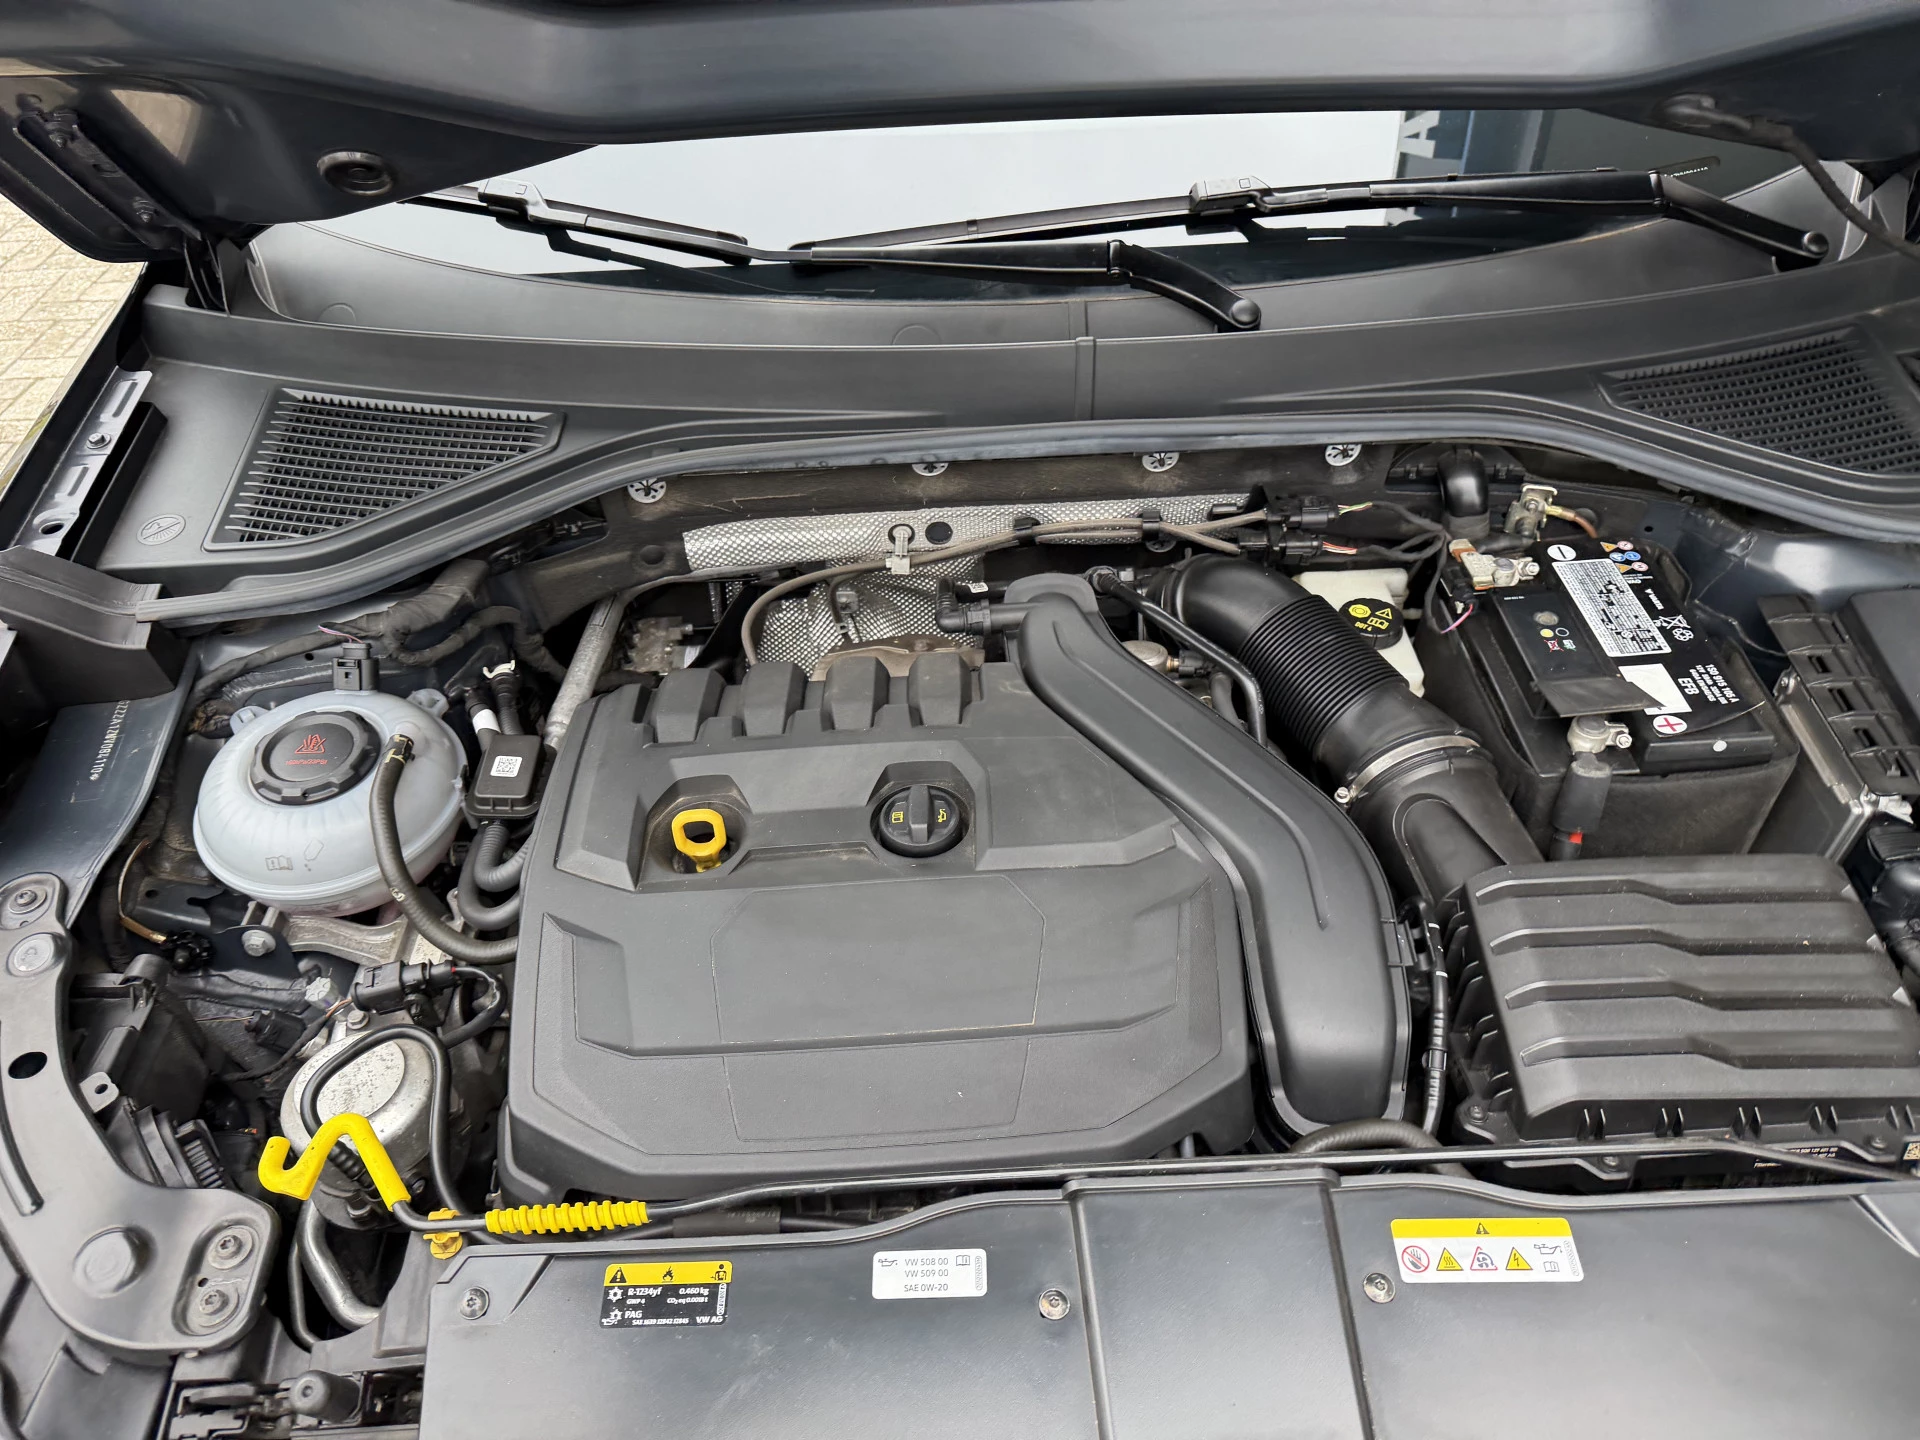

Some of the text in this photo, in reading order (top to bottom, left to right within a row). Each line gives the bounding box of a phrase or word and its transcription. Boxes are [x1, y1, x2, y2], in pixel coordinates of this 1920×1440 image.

[1677, 677, 1700, 694] EFB
[905, 1257, 949, 1266] VW 508 00
[905, 1268, 949, 1278] VW 509 00
[628, 1287, 662, 1297] R-1234yf
[700, 1286, 710, 1296] kg
[904, 1283, 949, 1292] SAE 0W-20
[624, 1310, 643, 1319] PAG
[695, 1315, 711, 1324] VW
[710, 1315, 724, 1324] AG
